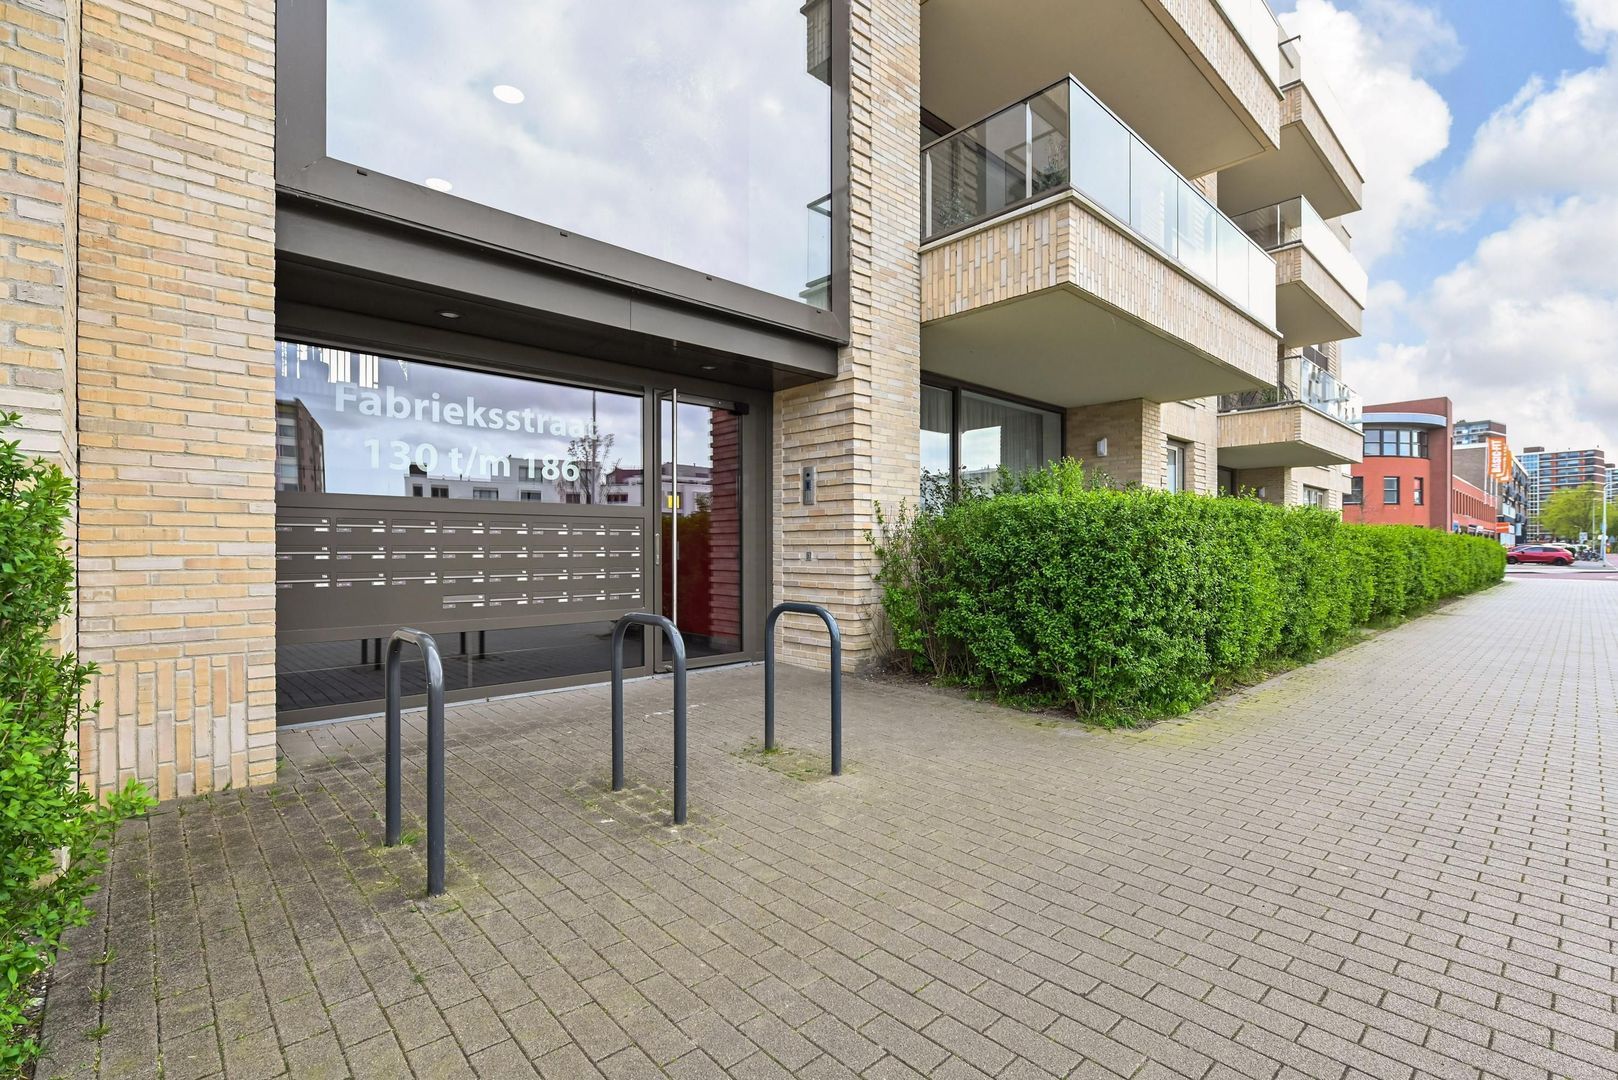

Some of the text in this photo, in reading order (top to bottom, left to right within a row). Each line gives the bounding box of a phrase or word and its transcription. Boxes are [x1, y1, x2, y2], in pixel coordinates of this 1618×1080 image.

[364, 439, 580, 482] 130 t/m 186
